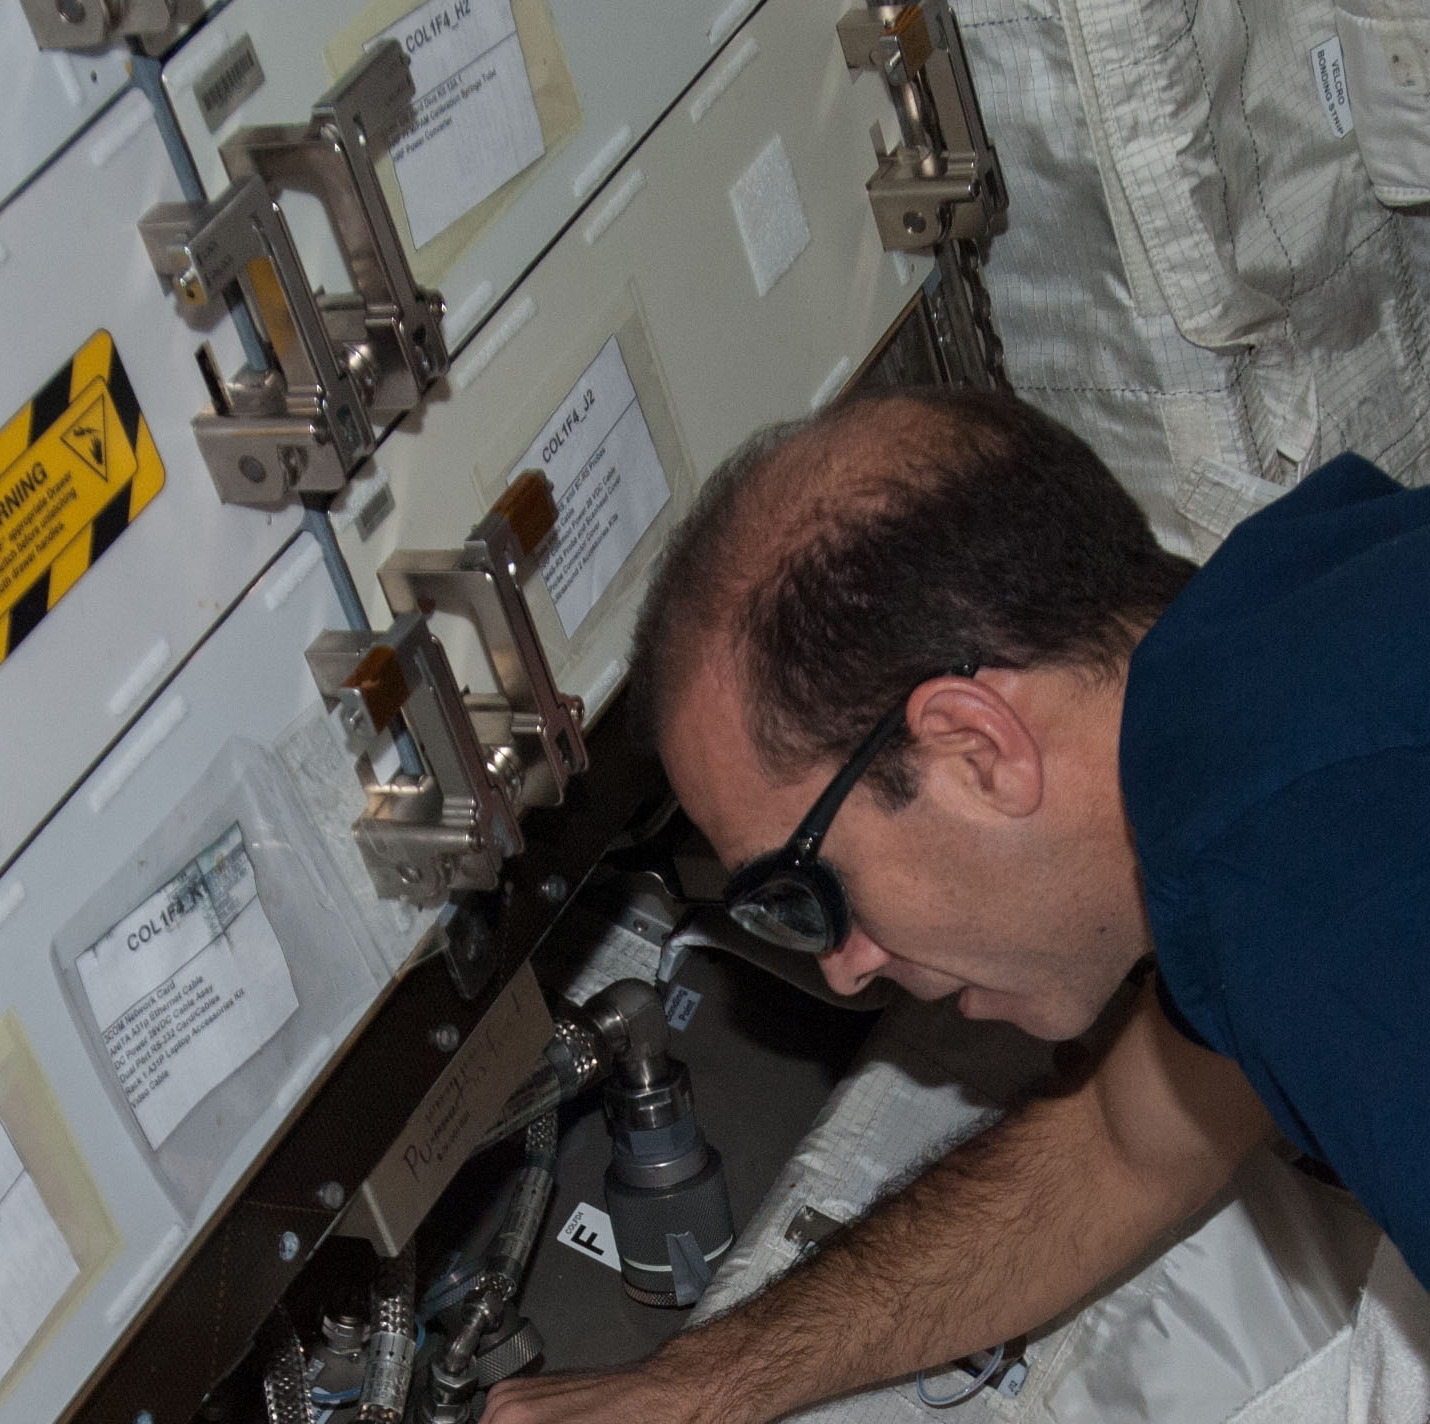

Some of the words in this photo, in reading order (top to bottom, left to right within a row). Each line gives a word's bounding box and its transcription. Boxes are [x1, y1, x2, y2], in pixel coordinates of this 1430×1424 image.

[1316, 49, 1332, 102] BONDING
[1328, 102, 1343, 136] STRIP
[1330, 59, 1345, 105] VELCRO
[541, 385, 596, 470] COL1F4_J2
[6, 494, 48, 544] appropriate
[45, 467, 72, 501] Drawer
[15, 522, 40, 553] before
[10, 548, 36, 580] drawer
[124, 993, 155, 1025] Network
[155, 978, 175, 1000] Card
[149, 990, 182, 1022] Ethernet
[181, 973, 203, 996] Cable
[678, 999, 696, 1021] Point
[118, 1064, 136, 1082] Dual
[135, 1051, 151, 1068] Port
[174, 990, 219, 1034] Card/Cables
[125, 1036, 148, 1059] Power
[171, 995, 194, 1020] Cable
[125, 1077, 142, 1095] Rack
[165, 1032, 191, 1059] Laptop
[190, 995, 234, 1038] Accessories
[232, 985, 244, 1001] Kit
[149, 1069, 169, 1091] Cable
[570, 1223, 612, 1255] F
